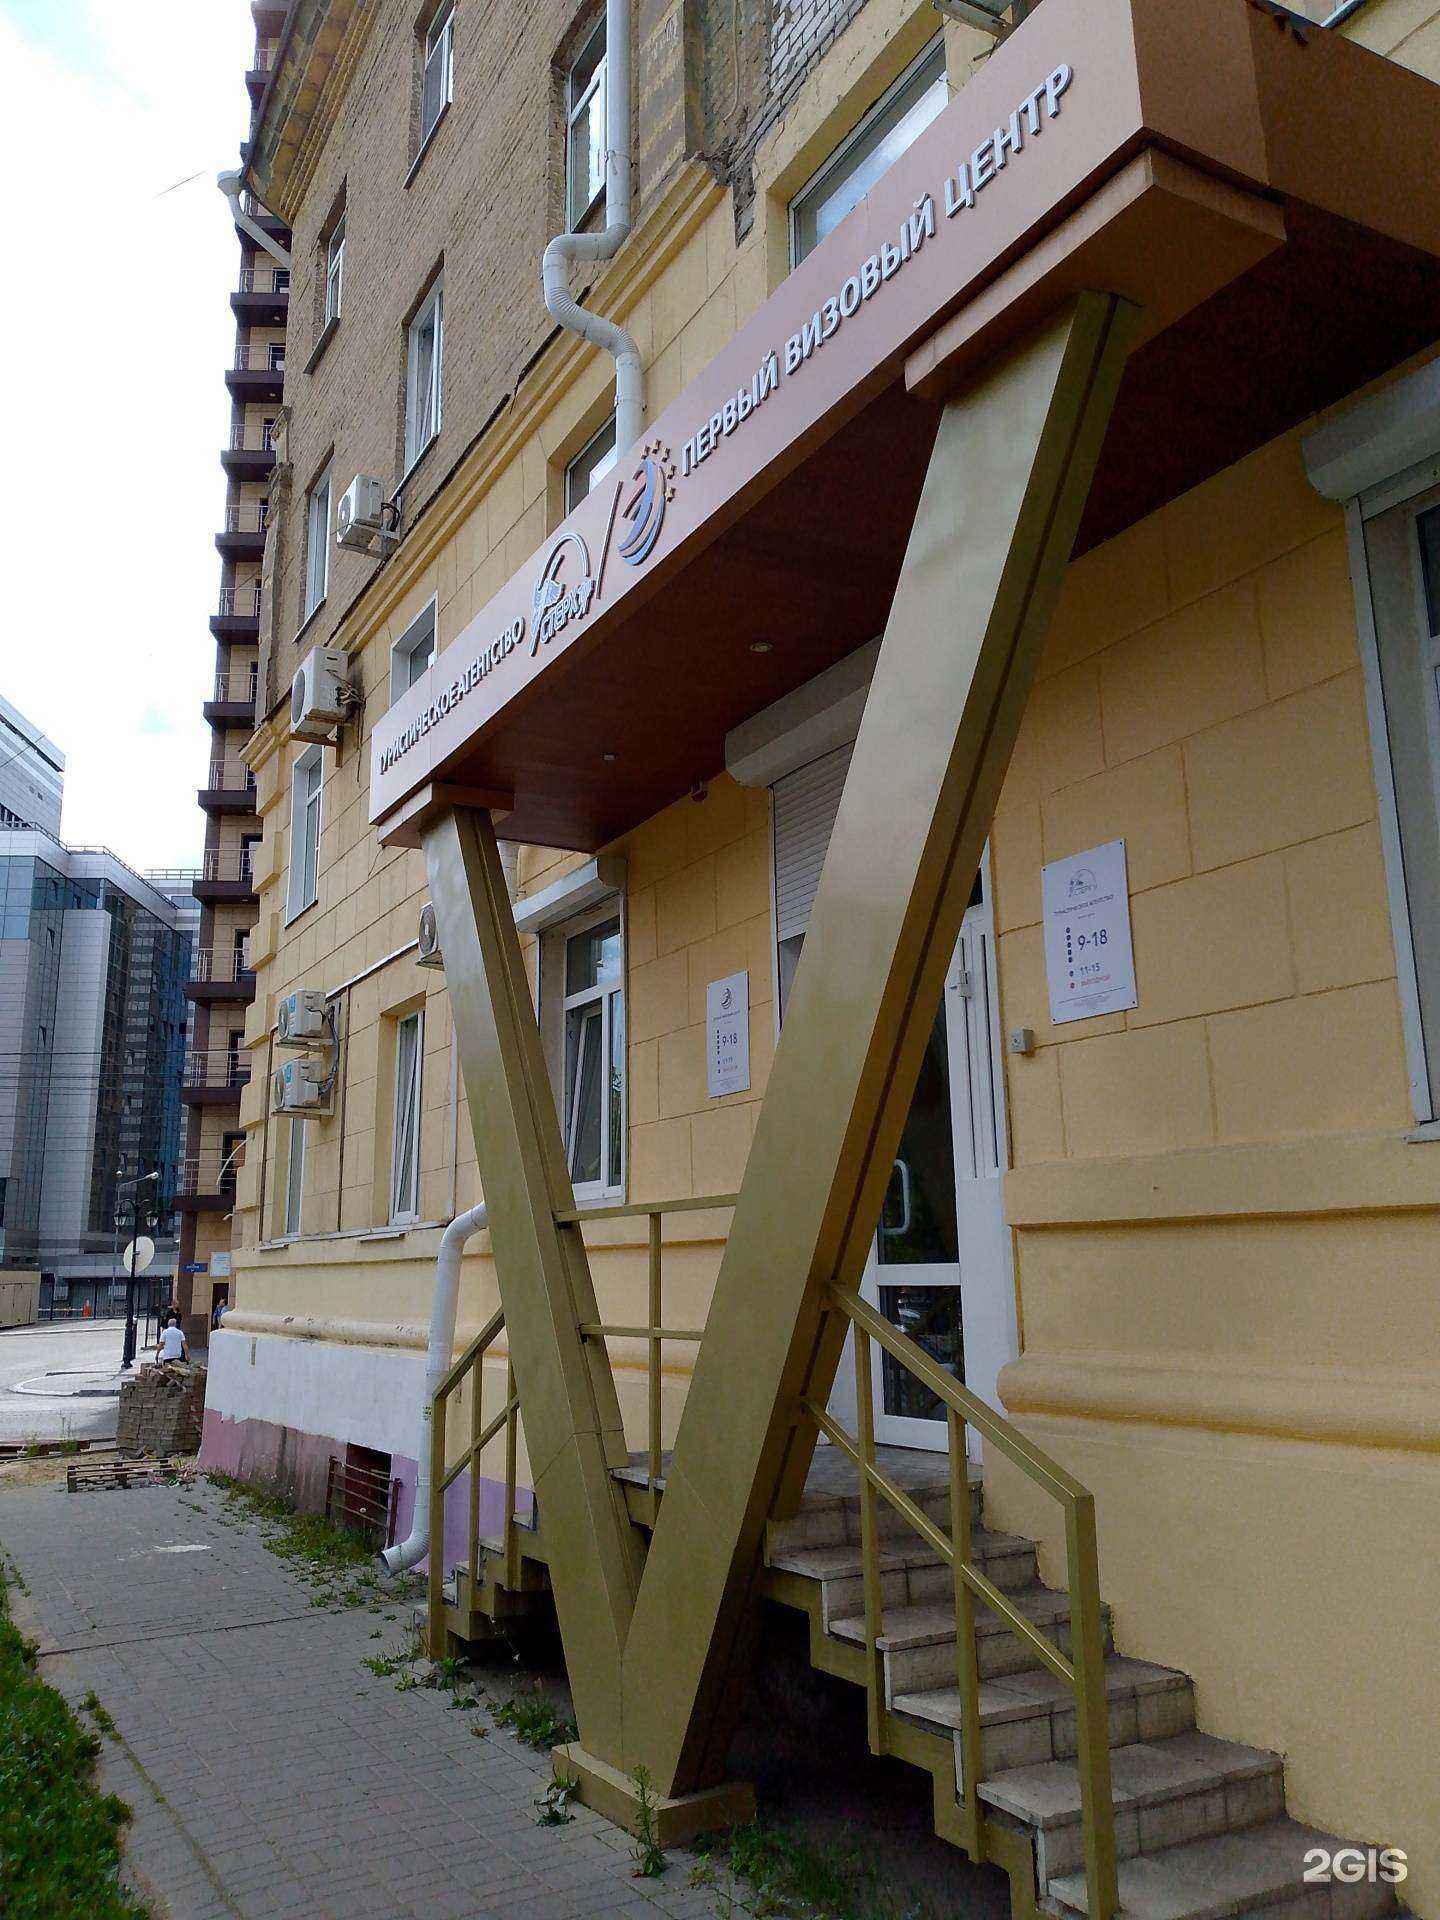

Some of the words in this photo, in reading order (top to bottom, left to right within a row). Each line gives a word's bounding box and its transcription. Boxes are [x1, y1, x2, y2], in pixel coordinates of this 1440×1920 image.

[680, 349, 779, 477] ПЕРВЫЙ
[784, 193, 937, 377] ВИЗОВЫЙ
[944, 63, 1074, 219] ЦЕНТР
[458, 616, 526, 701] АГЕНТСТВО
[1077, 929, 1108, 951] 9-18
